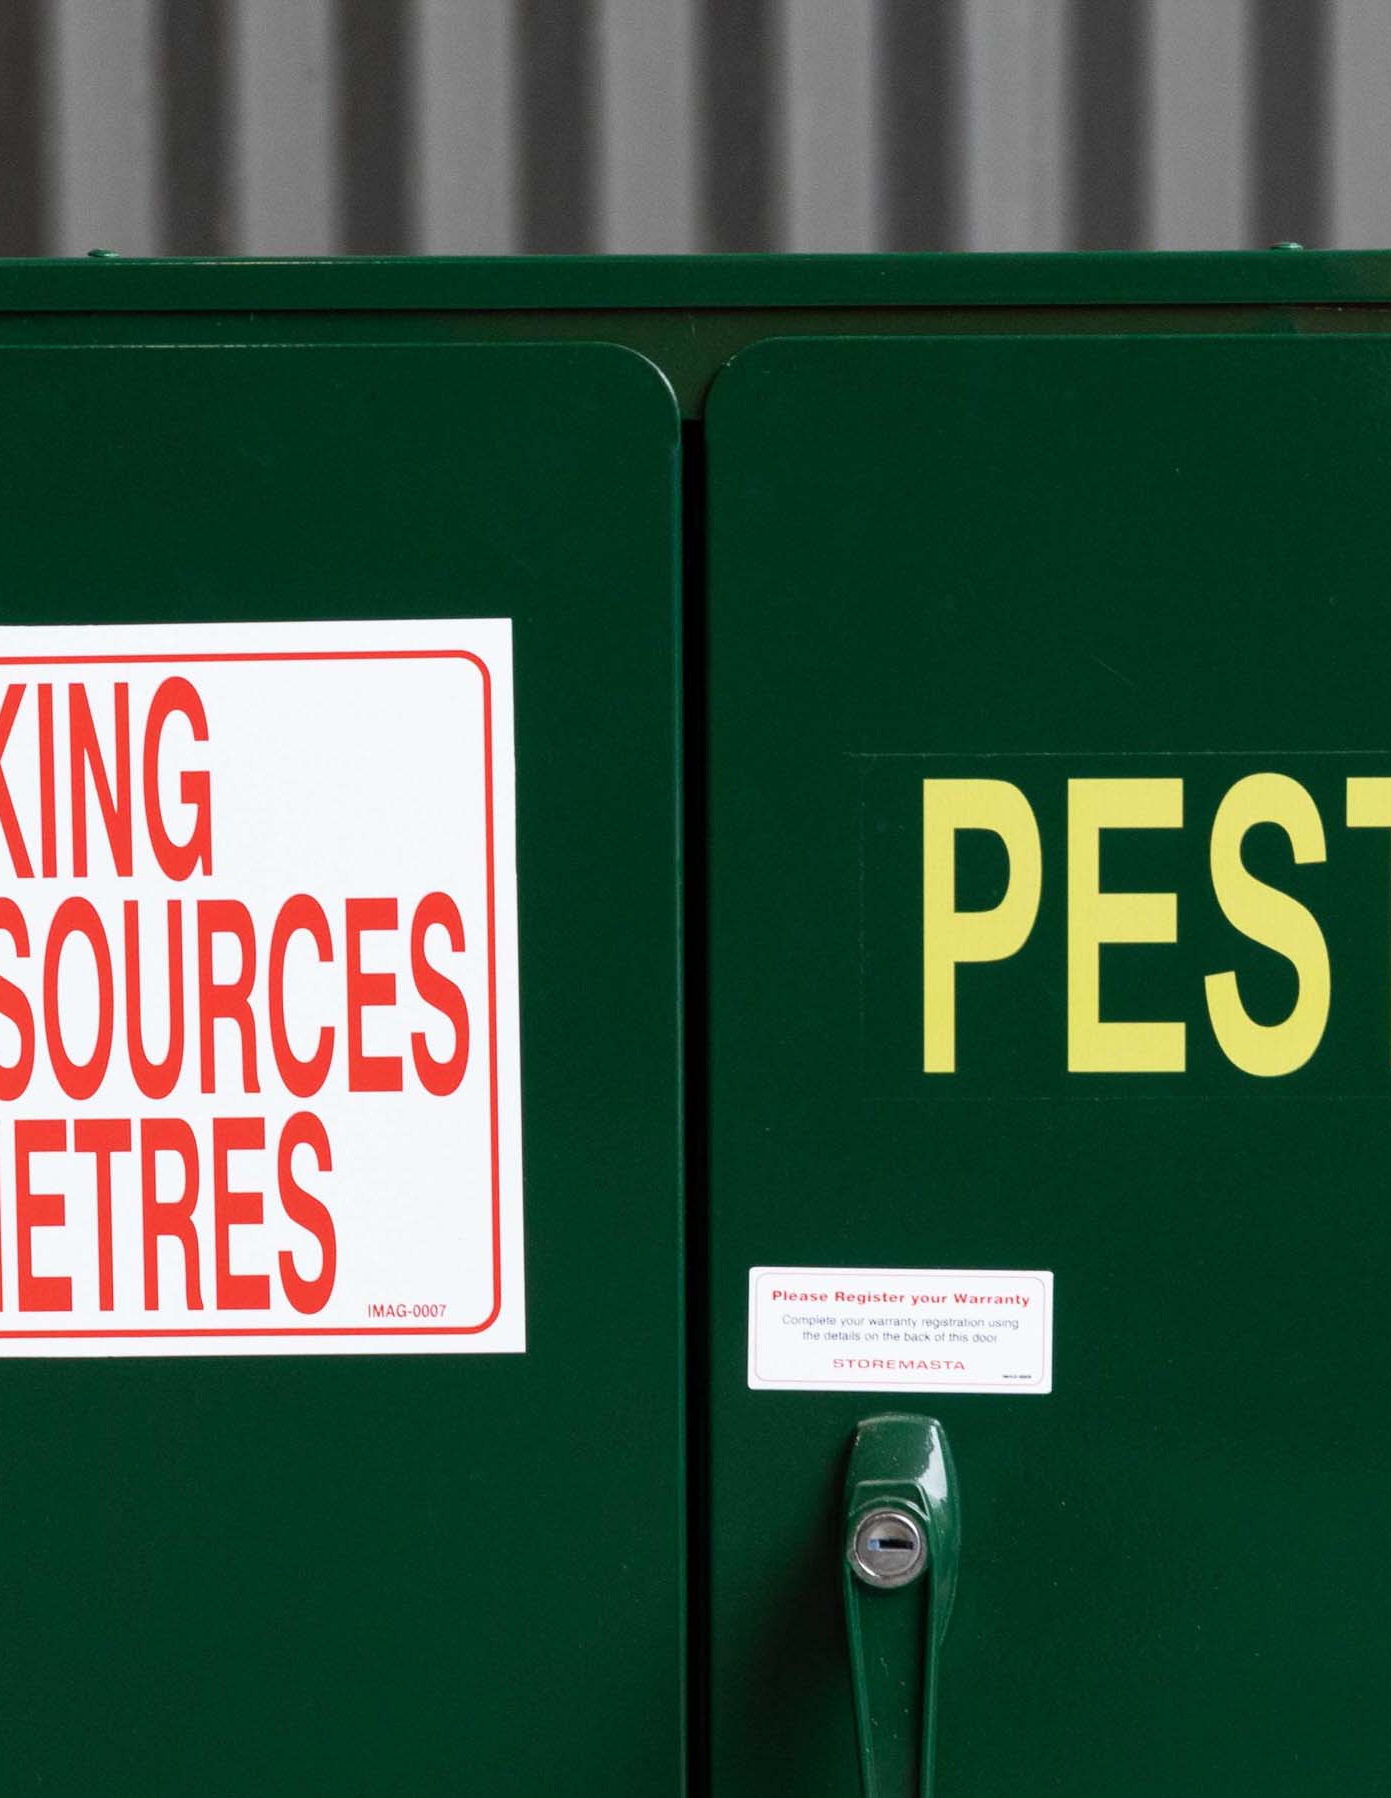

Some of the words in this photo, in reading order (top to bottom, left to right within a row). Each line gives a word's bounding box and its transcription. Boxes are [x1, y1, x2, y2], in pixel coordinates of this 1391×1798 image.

[772, 1290, 828, 1302] Please
[834, 1291, 905, 1305] Register
[911, 1295, 947, 1306] your
[953, 1293, 1030, 1308] Warranty
[367, 1303, 447, 1318] IMAG-0007
[782, 1314, 836, 1327] Complete
[840, 1317, 865, 1328] your
[868, 1317, 917, 1329] warranty
[921, 1317, 984, 1330] registration
[988, 1319, 1019, 1330] using
[802, 1330, 821, 1341] the
[824, 1330, 861, 1341] details
[864, 1332, 879, 1341] on
[882, 1331, 900, 1341] the
[903, 1332, 930, 1343] back
[934, 1332, 945, 1342] of
[948, 1332, 969, 1343] this
[832, 1358, 966, 1370] STOREMASTA
